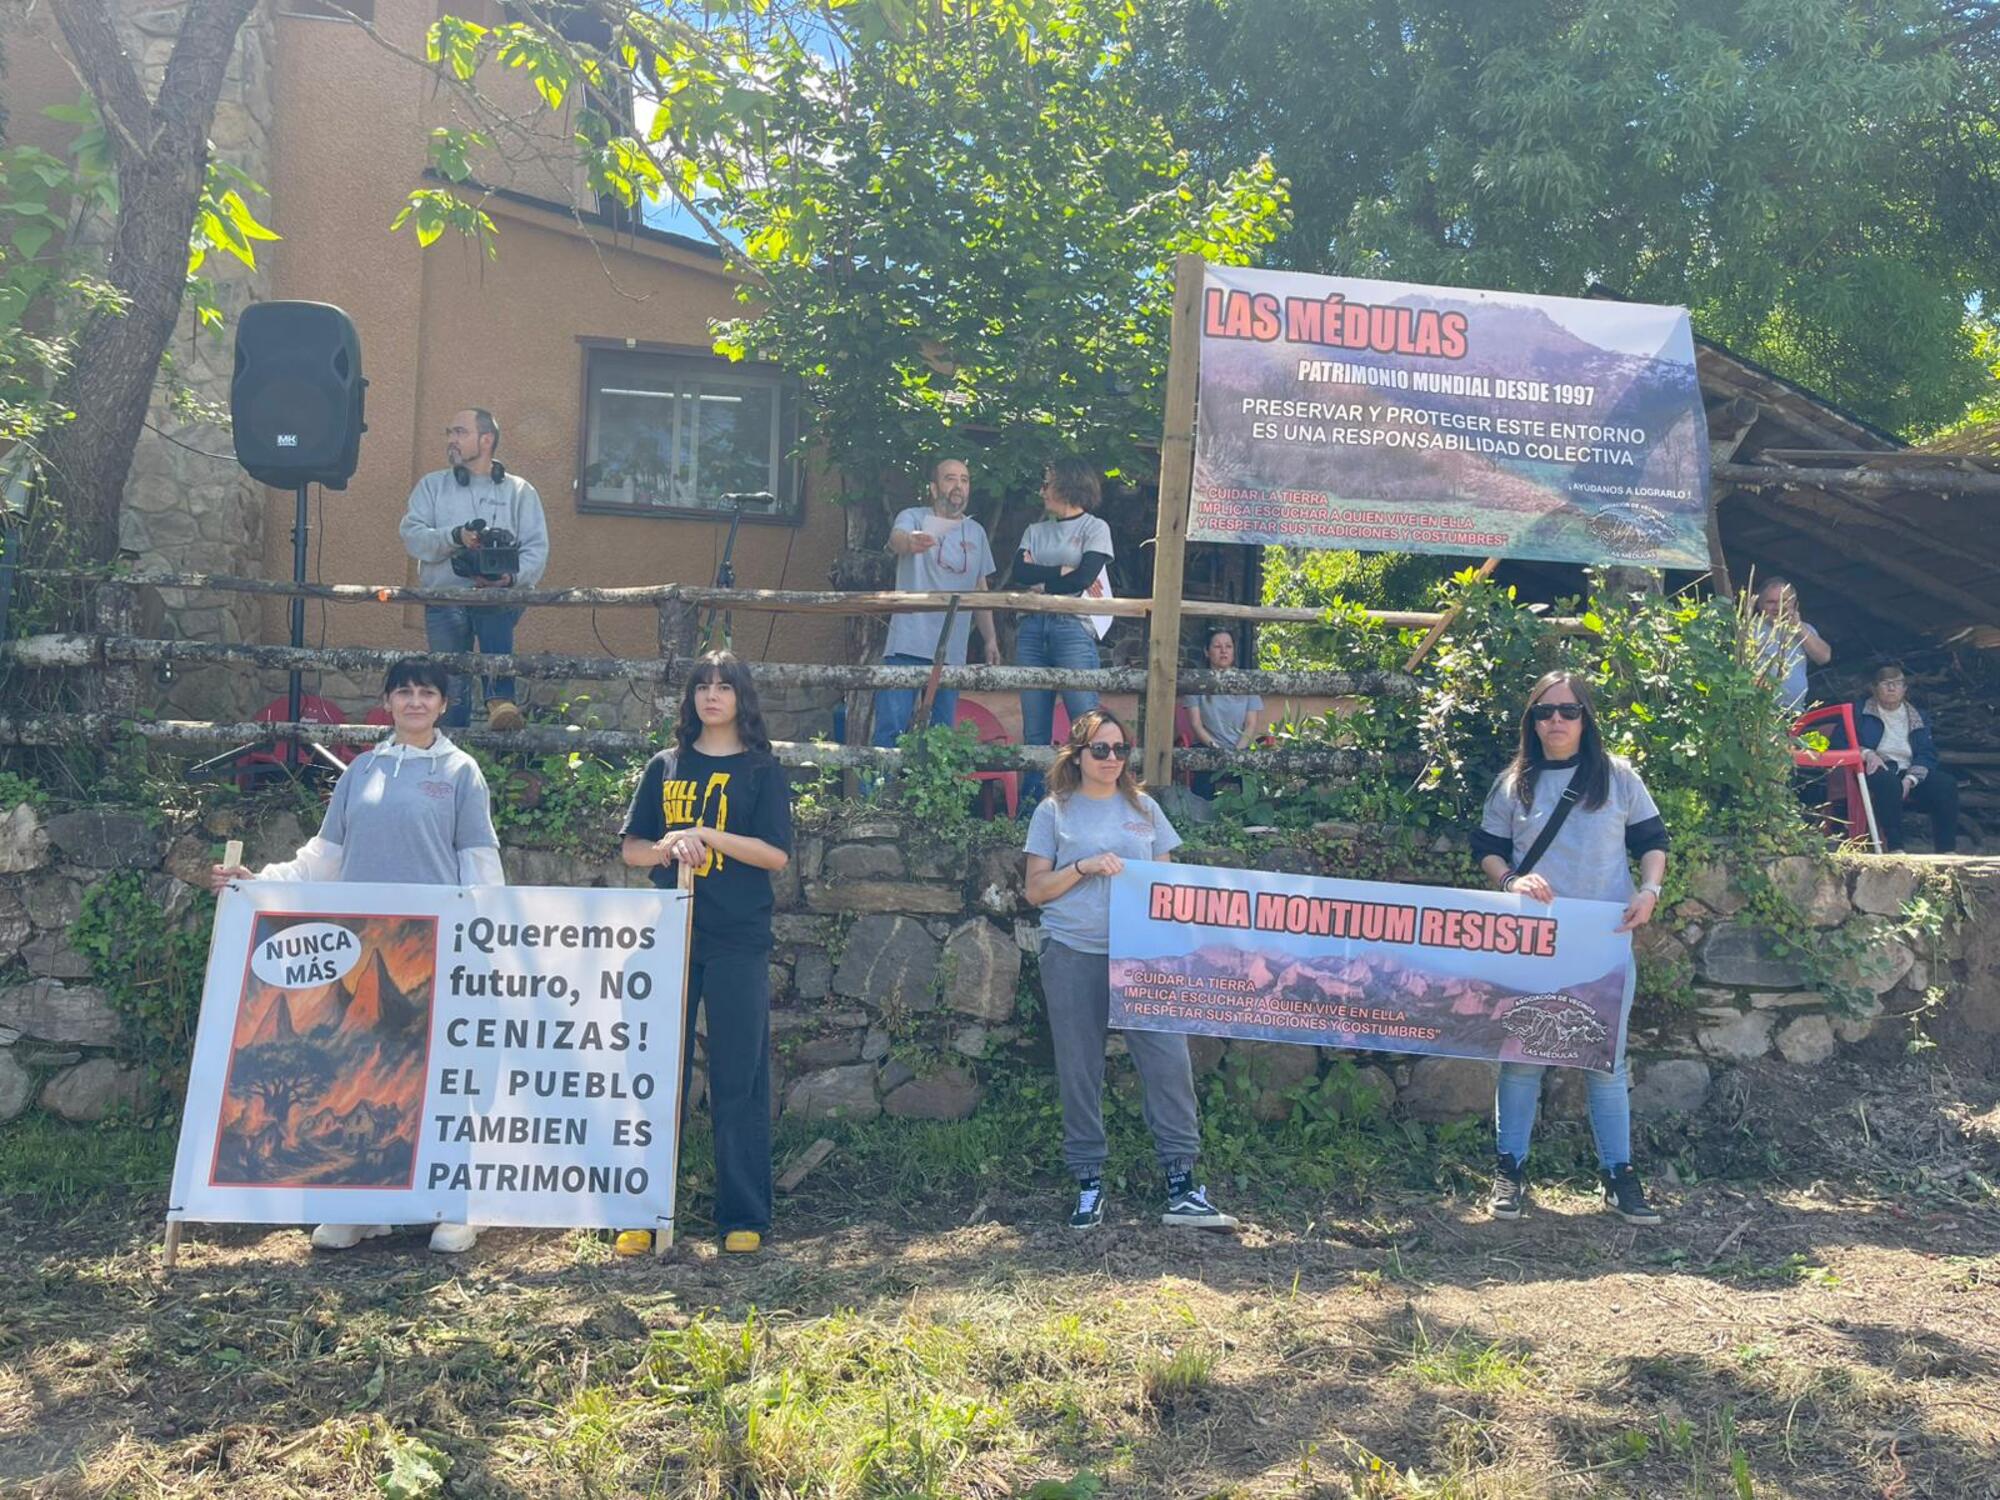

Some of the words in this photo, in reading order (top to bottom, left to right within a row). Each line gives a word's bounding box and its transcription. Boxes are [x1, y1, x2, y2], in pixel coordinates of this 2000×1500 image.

[1204, 287, 1281, 342] LAS
[1285, 293, 1469, 360] MÉDULAS
[1298, 360, 1408, 390] PATRIMONIO
[1413, 372, 1491, 398] MUNDIAL
[1495, 379, 1549, 402] DESDE
[1553, 384, 1595, 406] 1997
[1242, 398, 1363, 422] PRESERVAR
[1369, 406, 1382, 422] Y
[1387, 407, 1492, 433] PROTEGER
[1496, 418, 1545, 438] ESTE
[1550, 422, 1646, 445] ENTORNO
[1253, 422, 1278, 440] ES
[1284, 424, 1326, 443] UNA
[1332, 427, 1520, 457] RESPONSABILIDAD
[1525, 442, 1634, 467] COLECTIVA
[1261, 490, 1279, 502] LA
[1281, 491, 1329, 505] TIERRA
[1625, 486, 1634, 496] A
[1198, 517, 1206, 529] Y
[1208, 518, 1278, 533] RESPETAR
[1280, 522, 1307, 535] SUS
[1311, 524, 1398, 539] TRADICIONES
[1400, 529, 1410, 541] Y
[1199, 503, 1252, 516] IMPLICA
[1254, 505, 1328, 521] ESCUCHAR
[1331, 509, 1341, 522] A
[1342, 510, 1384, 524] QUIEN
[1386, 513, 1417, 526] VIVE
[1419, 515, 1439, 527] EN
[1441, 517, 1475, 529] ELLA
[663, 780, 698, 800] KILL
[663, 799, 695, 825] BILL
[453, 917, 656, 954] ¡Queremos
[1150, 882, 1251, 930] RUINA
[1254, 891, 1417, 944] MONTIUM
[1419, 906, 1558, 957] RESISTE
[265, 930, 352, 961] NUNCA
[285, 956, 337, 985] MÁS
[450, 965, 580, 1007] futuro,
[600, 970, 652, 1001] NO
[1187, 976, 1204, 988] LA
[1208, 977, 1256, 992] TIERRA
[1123, 1001, 1133, 1013] Y
[1134, 1002, 1202, 1019] RESPETAR
[1206, 1009, 1232, 1022] SUS
[1236, 1011, 1328, 1031] TRADICIONES
[1328, 1019, 1339, 1031] Y
[1124, 986, 1177, 1001] IMPLICA
[1181, 991, 1254, 1008] ESCUCHAR
[1257, 998, 1268, 1010] A
[1270, 999, 1312, 1013] QUIEN
[1315, 1003, 1346, 1016] VIVE
[1349, 1006, 1368, 1019] EN
[1371, 1008, 1406, 1022] ELLA
[1558, 995, 1568, 1003] DE
[1568, 997, 1597, 1016] VECINOS
[446, 1017, 648, 1053] CENIZAS!
[440, 1068, 481, 1096] EL
[508, 1069, 655, 1101] PUEBLO
[435, 1115, 588, 1146] TAMBIEN
[612, 1119, 652, 1148] ES
[427, 1162, 649, 1196] PATRIMONIO
